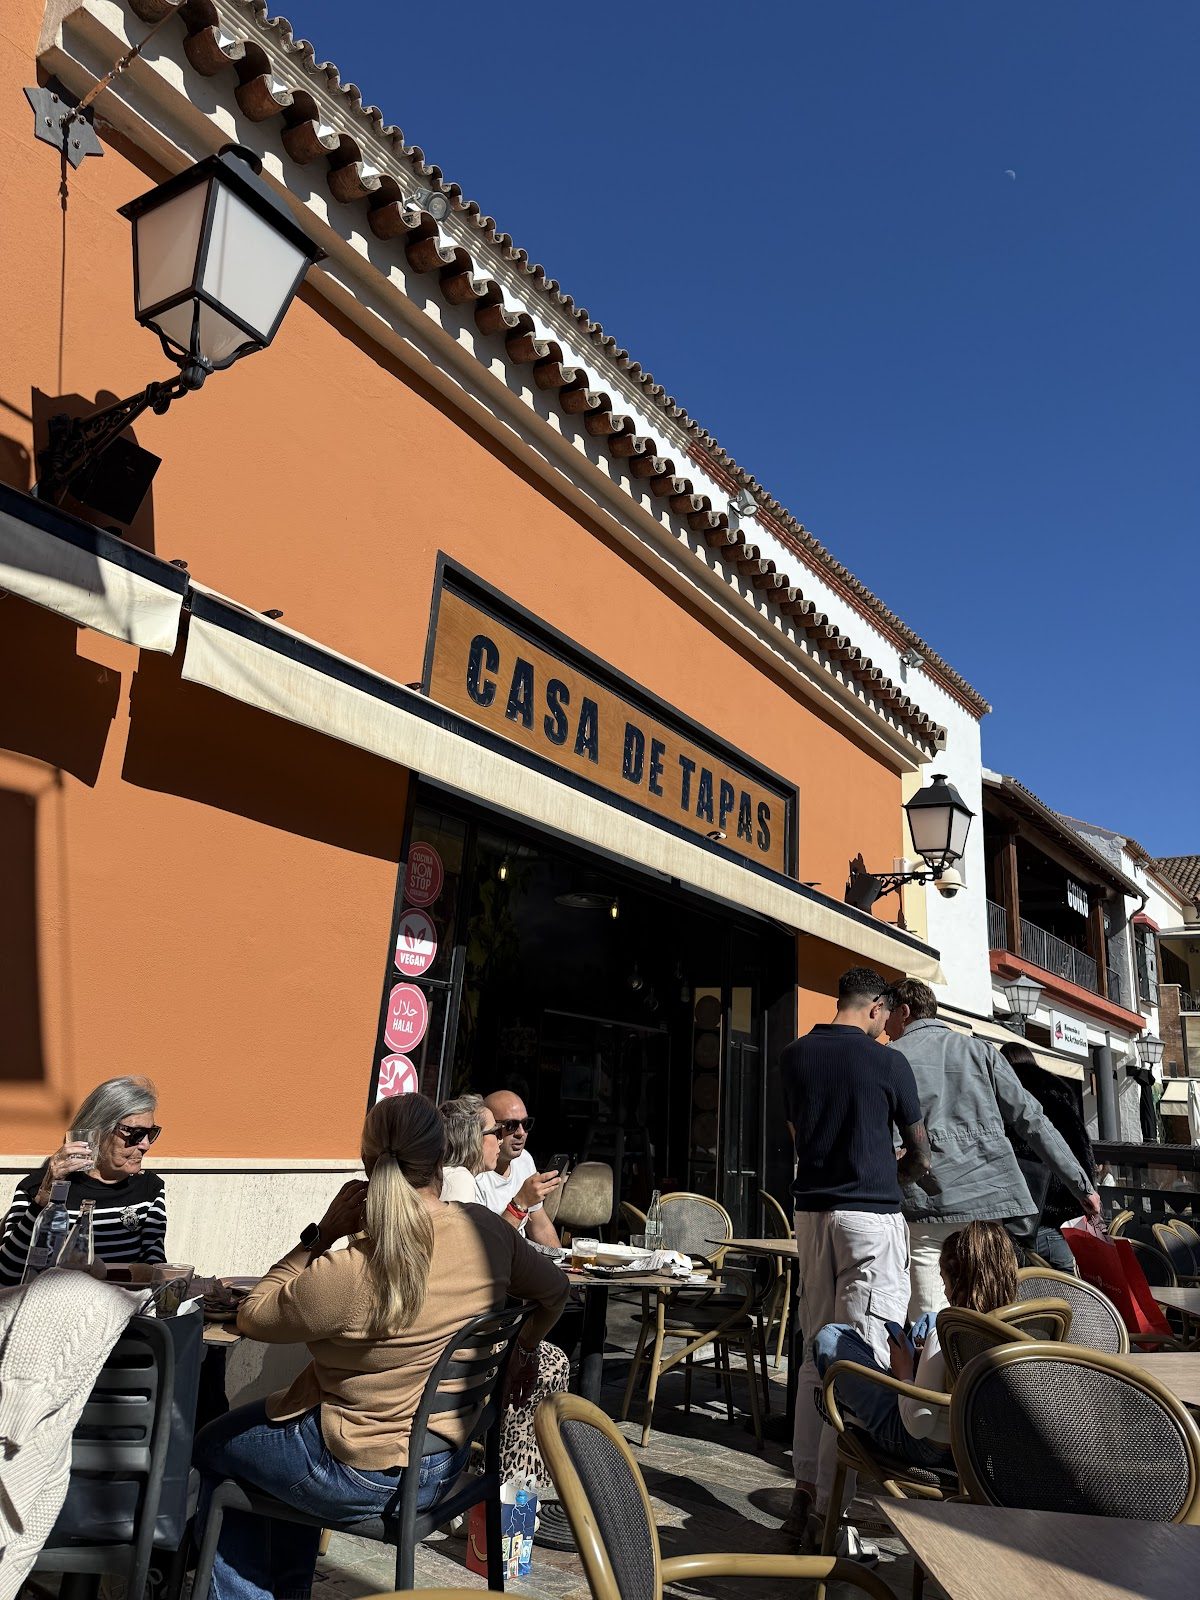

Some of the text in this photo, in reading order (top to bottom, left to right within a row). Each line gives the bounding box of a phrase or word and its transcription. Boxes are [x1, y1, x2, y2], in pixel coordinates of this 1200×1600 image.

[466, 634, 771, 853] CASA DE TAPAS
[411, 862, 433, 879] NON
[410, 874, 431, 891] STOP
[400, 952, 426, 967] VEGAN
[393, 999, 418, 1017] حلال
[392, 1017, 414, 1034] HALAL
